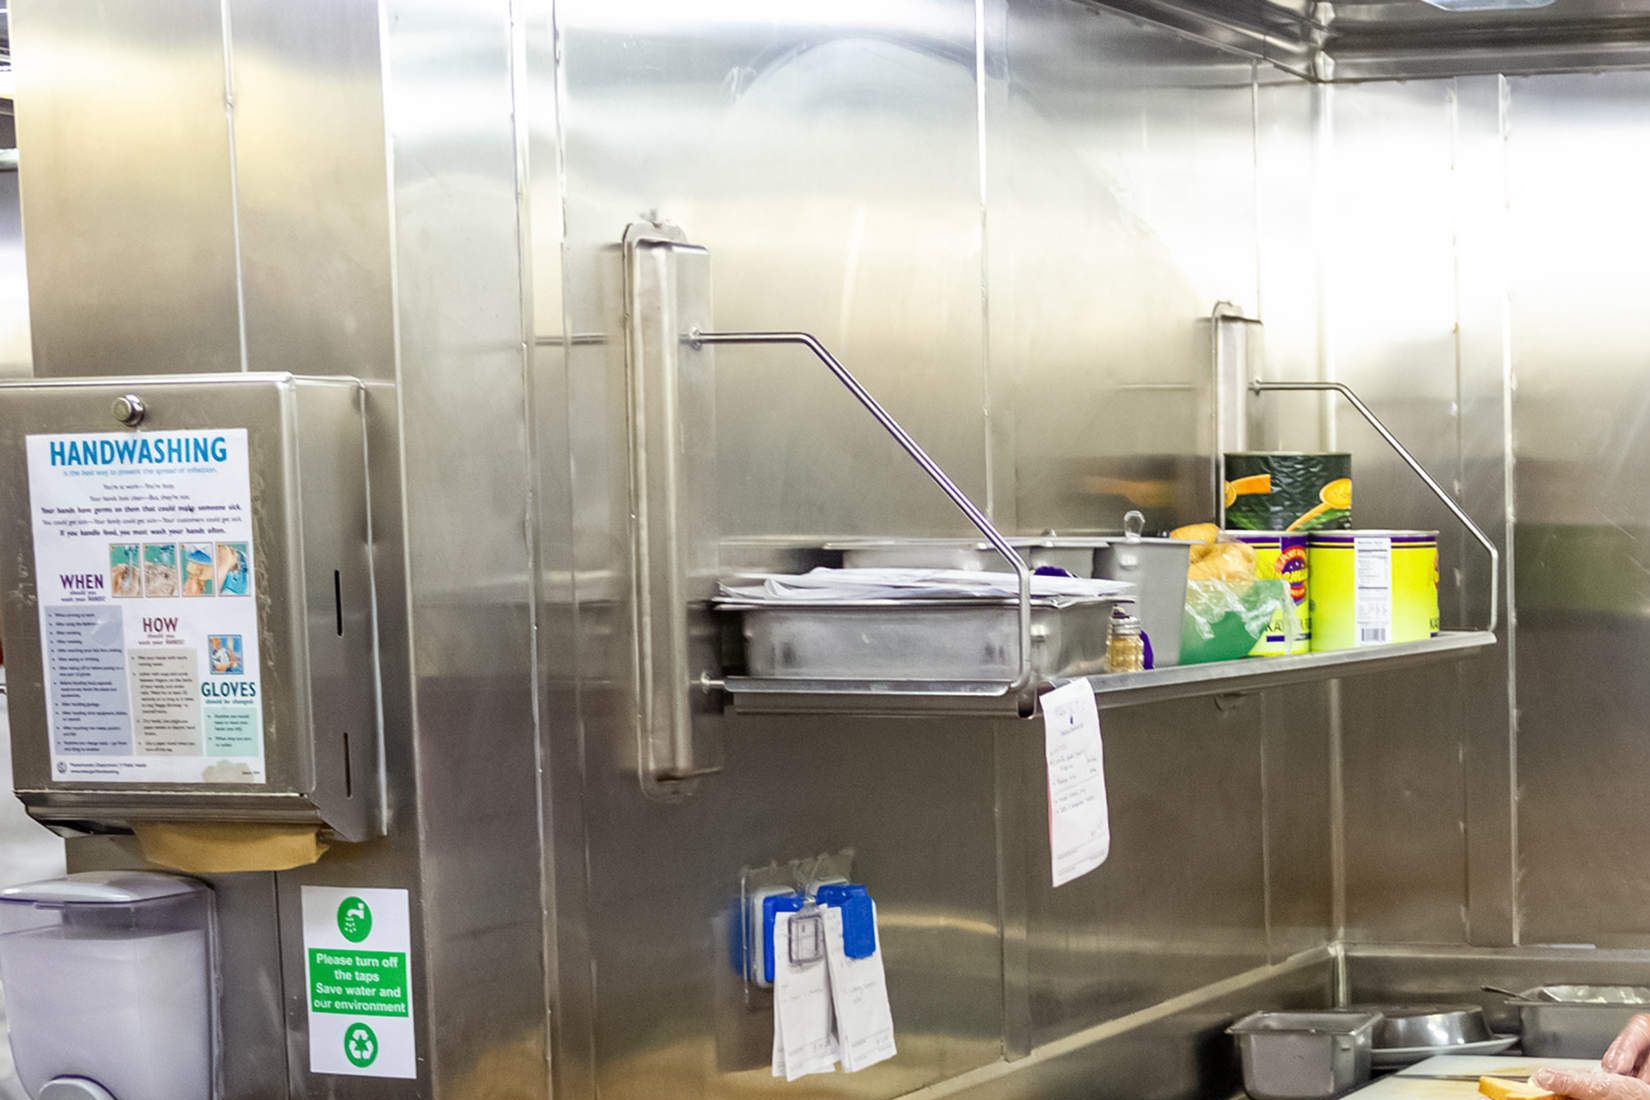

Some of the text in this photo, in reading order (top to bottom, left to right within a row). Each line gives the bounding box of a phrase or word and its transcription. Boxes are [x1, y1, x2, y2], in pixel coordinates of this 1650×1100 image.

[50, 436, 227, 466] HANDWASHING
[60, 574, 104, 589] WHEN
[142, 618, 178, 633] HOW
[201, 682, 256, 698] GLOVES
[316, 953, 399, 968] Please turn off
[334, 969, 380, 983] the taps
[316, 982, 402, 998] Save water and
[314, 999, 406, 1013] our environment
